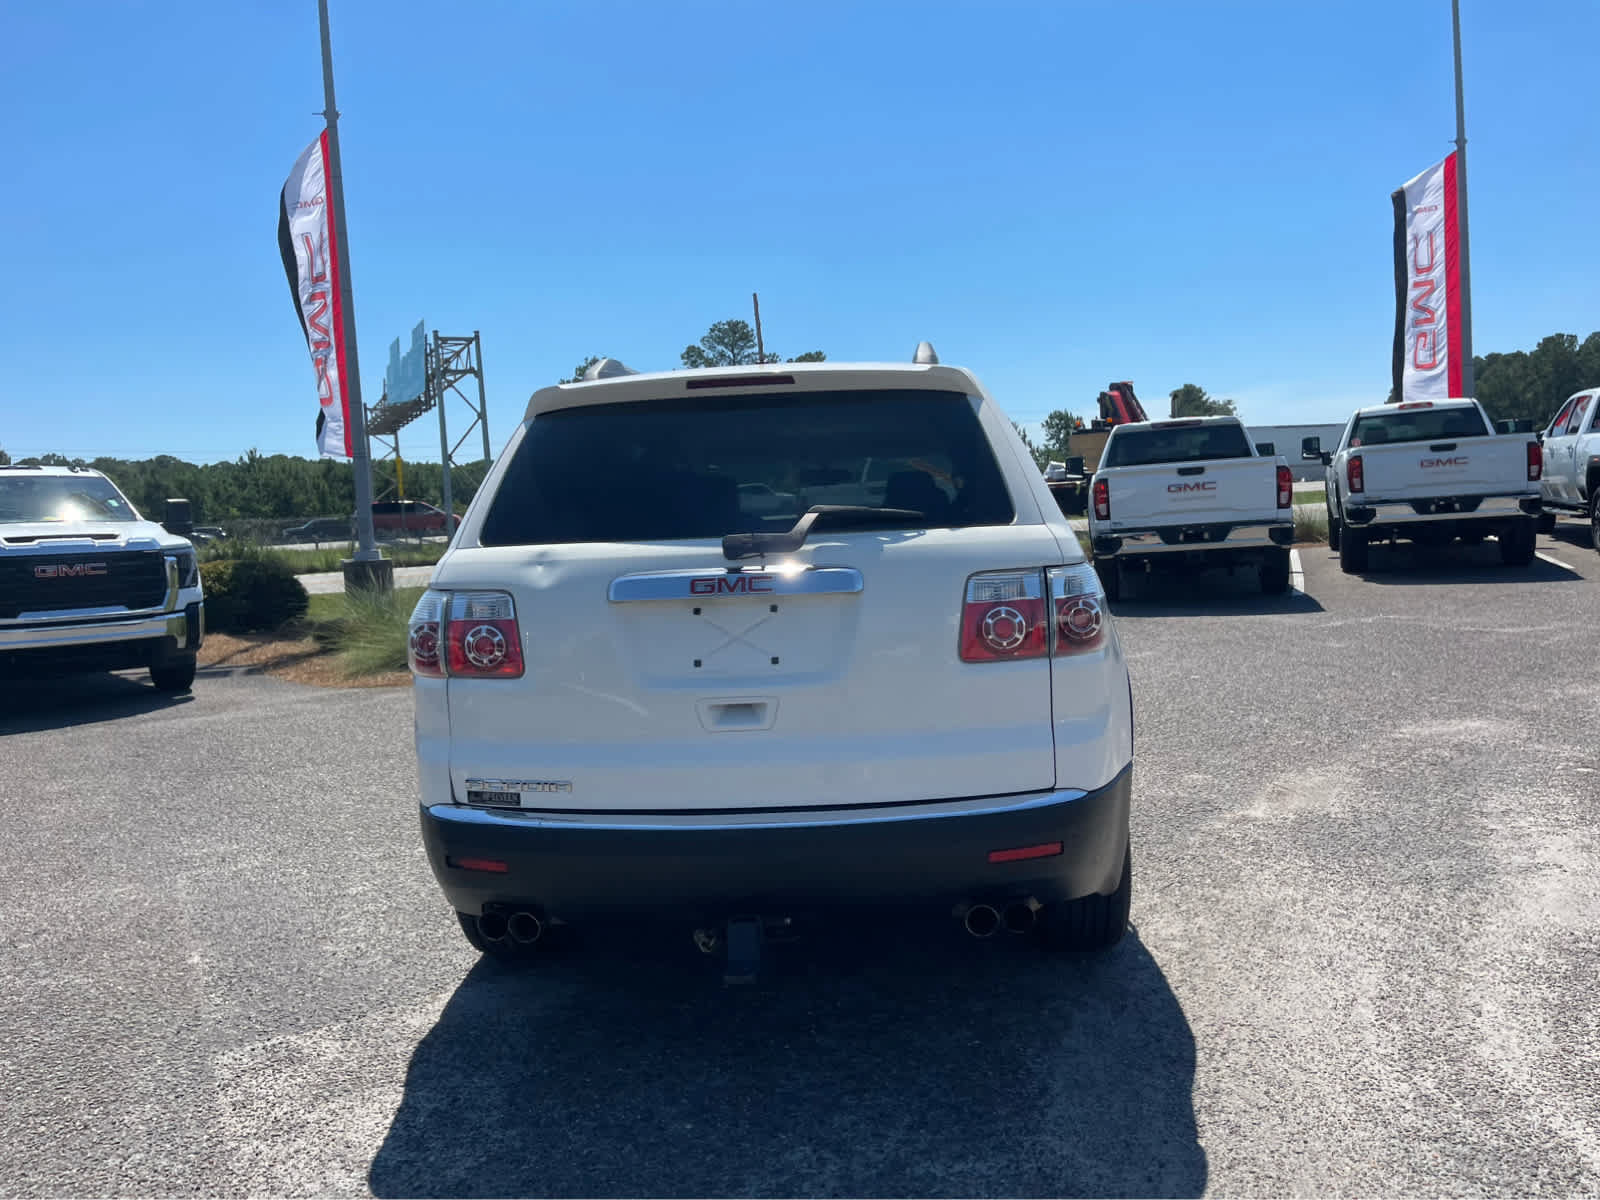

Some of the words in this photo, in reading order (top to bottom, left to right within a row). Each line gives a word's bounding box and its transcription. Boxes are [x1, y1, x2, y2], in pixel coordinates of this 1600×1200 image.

[1420, 456, 1469, 469] GMC
[1167, 481, 1217, 493] GMC
[34, 562, 107, 578] GMC
[690, 575, 774, 595] GMC
